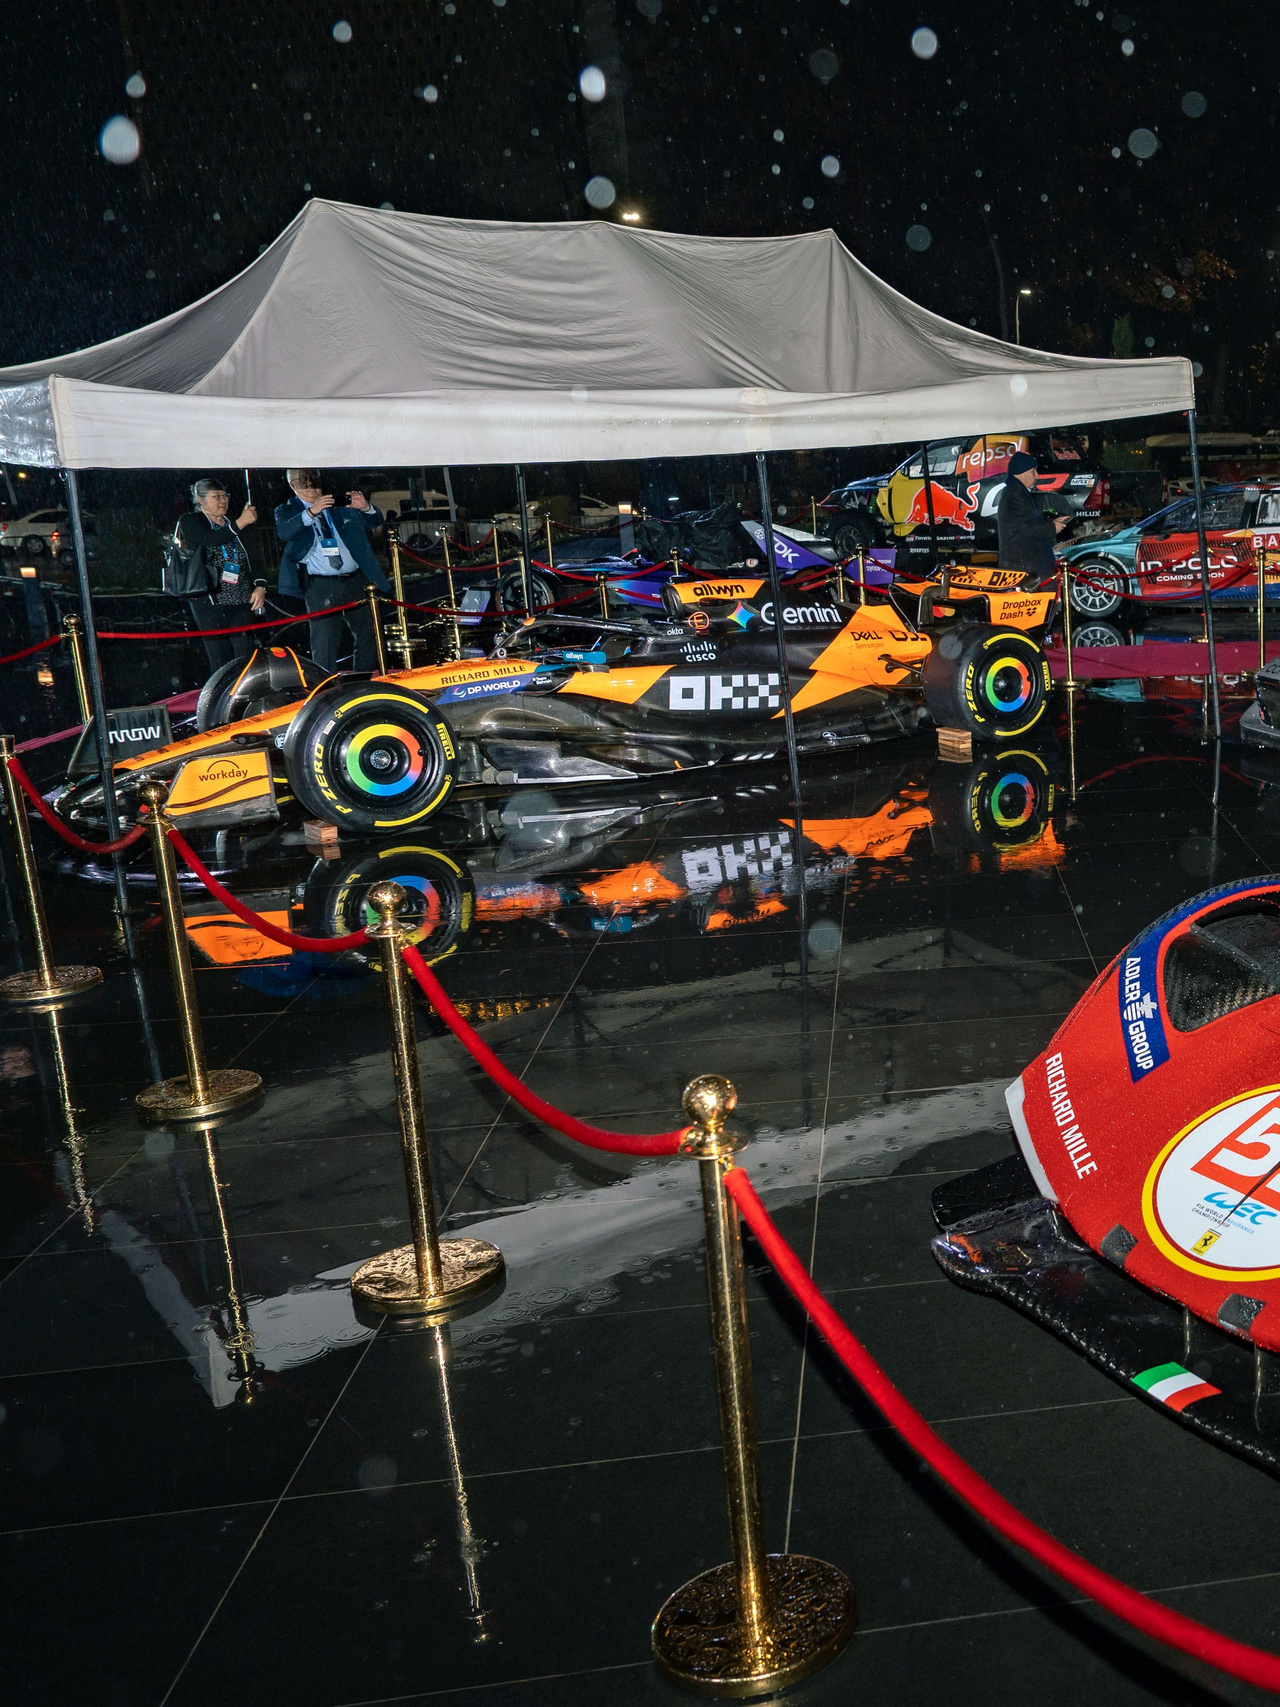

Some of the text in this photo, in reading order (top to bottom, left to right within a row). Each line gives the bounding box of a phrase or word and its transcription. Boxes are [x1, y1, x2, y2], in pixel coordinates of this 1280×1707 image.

[1156, 572, 1225, 582] COMING SON
[693, 582, 745, 598] allwyn
[760, 602, 843, 626] Gemini
[1002, 599, 1042, 611] Dropbox
[1000, 610, 1024, 620] Dash
[666, 626, 684, 636] okta
[850, 630, 883, 642] DELL
[440, 664, 527, 685] RICHARD MILLE
[467, 680, 521, 695] DP WORLD
[668, 673, 780, 710] OKX
[965, 664, 979, 712] ZERO
[436, 722, 456, 761] PIRELLI
[198, 768, 248, 783] workday
[314, 743, 353, 814] P ZERO
[1125, 956, 1154, 1070] ADLER GROUP
[1046, 1052, 1098, 1180] RICHARD MILLE
[1203, 1192, 1278, 1225] WEC
[1204, 1208, 1224, 1219] WORLD
